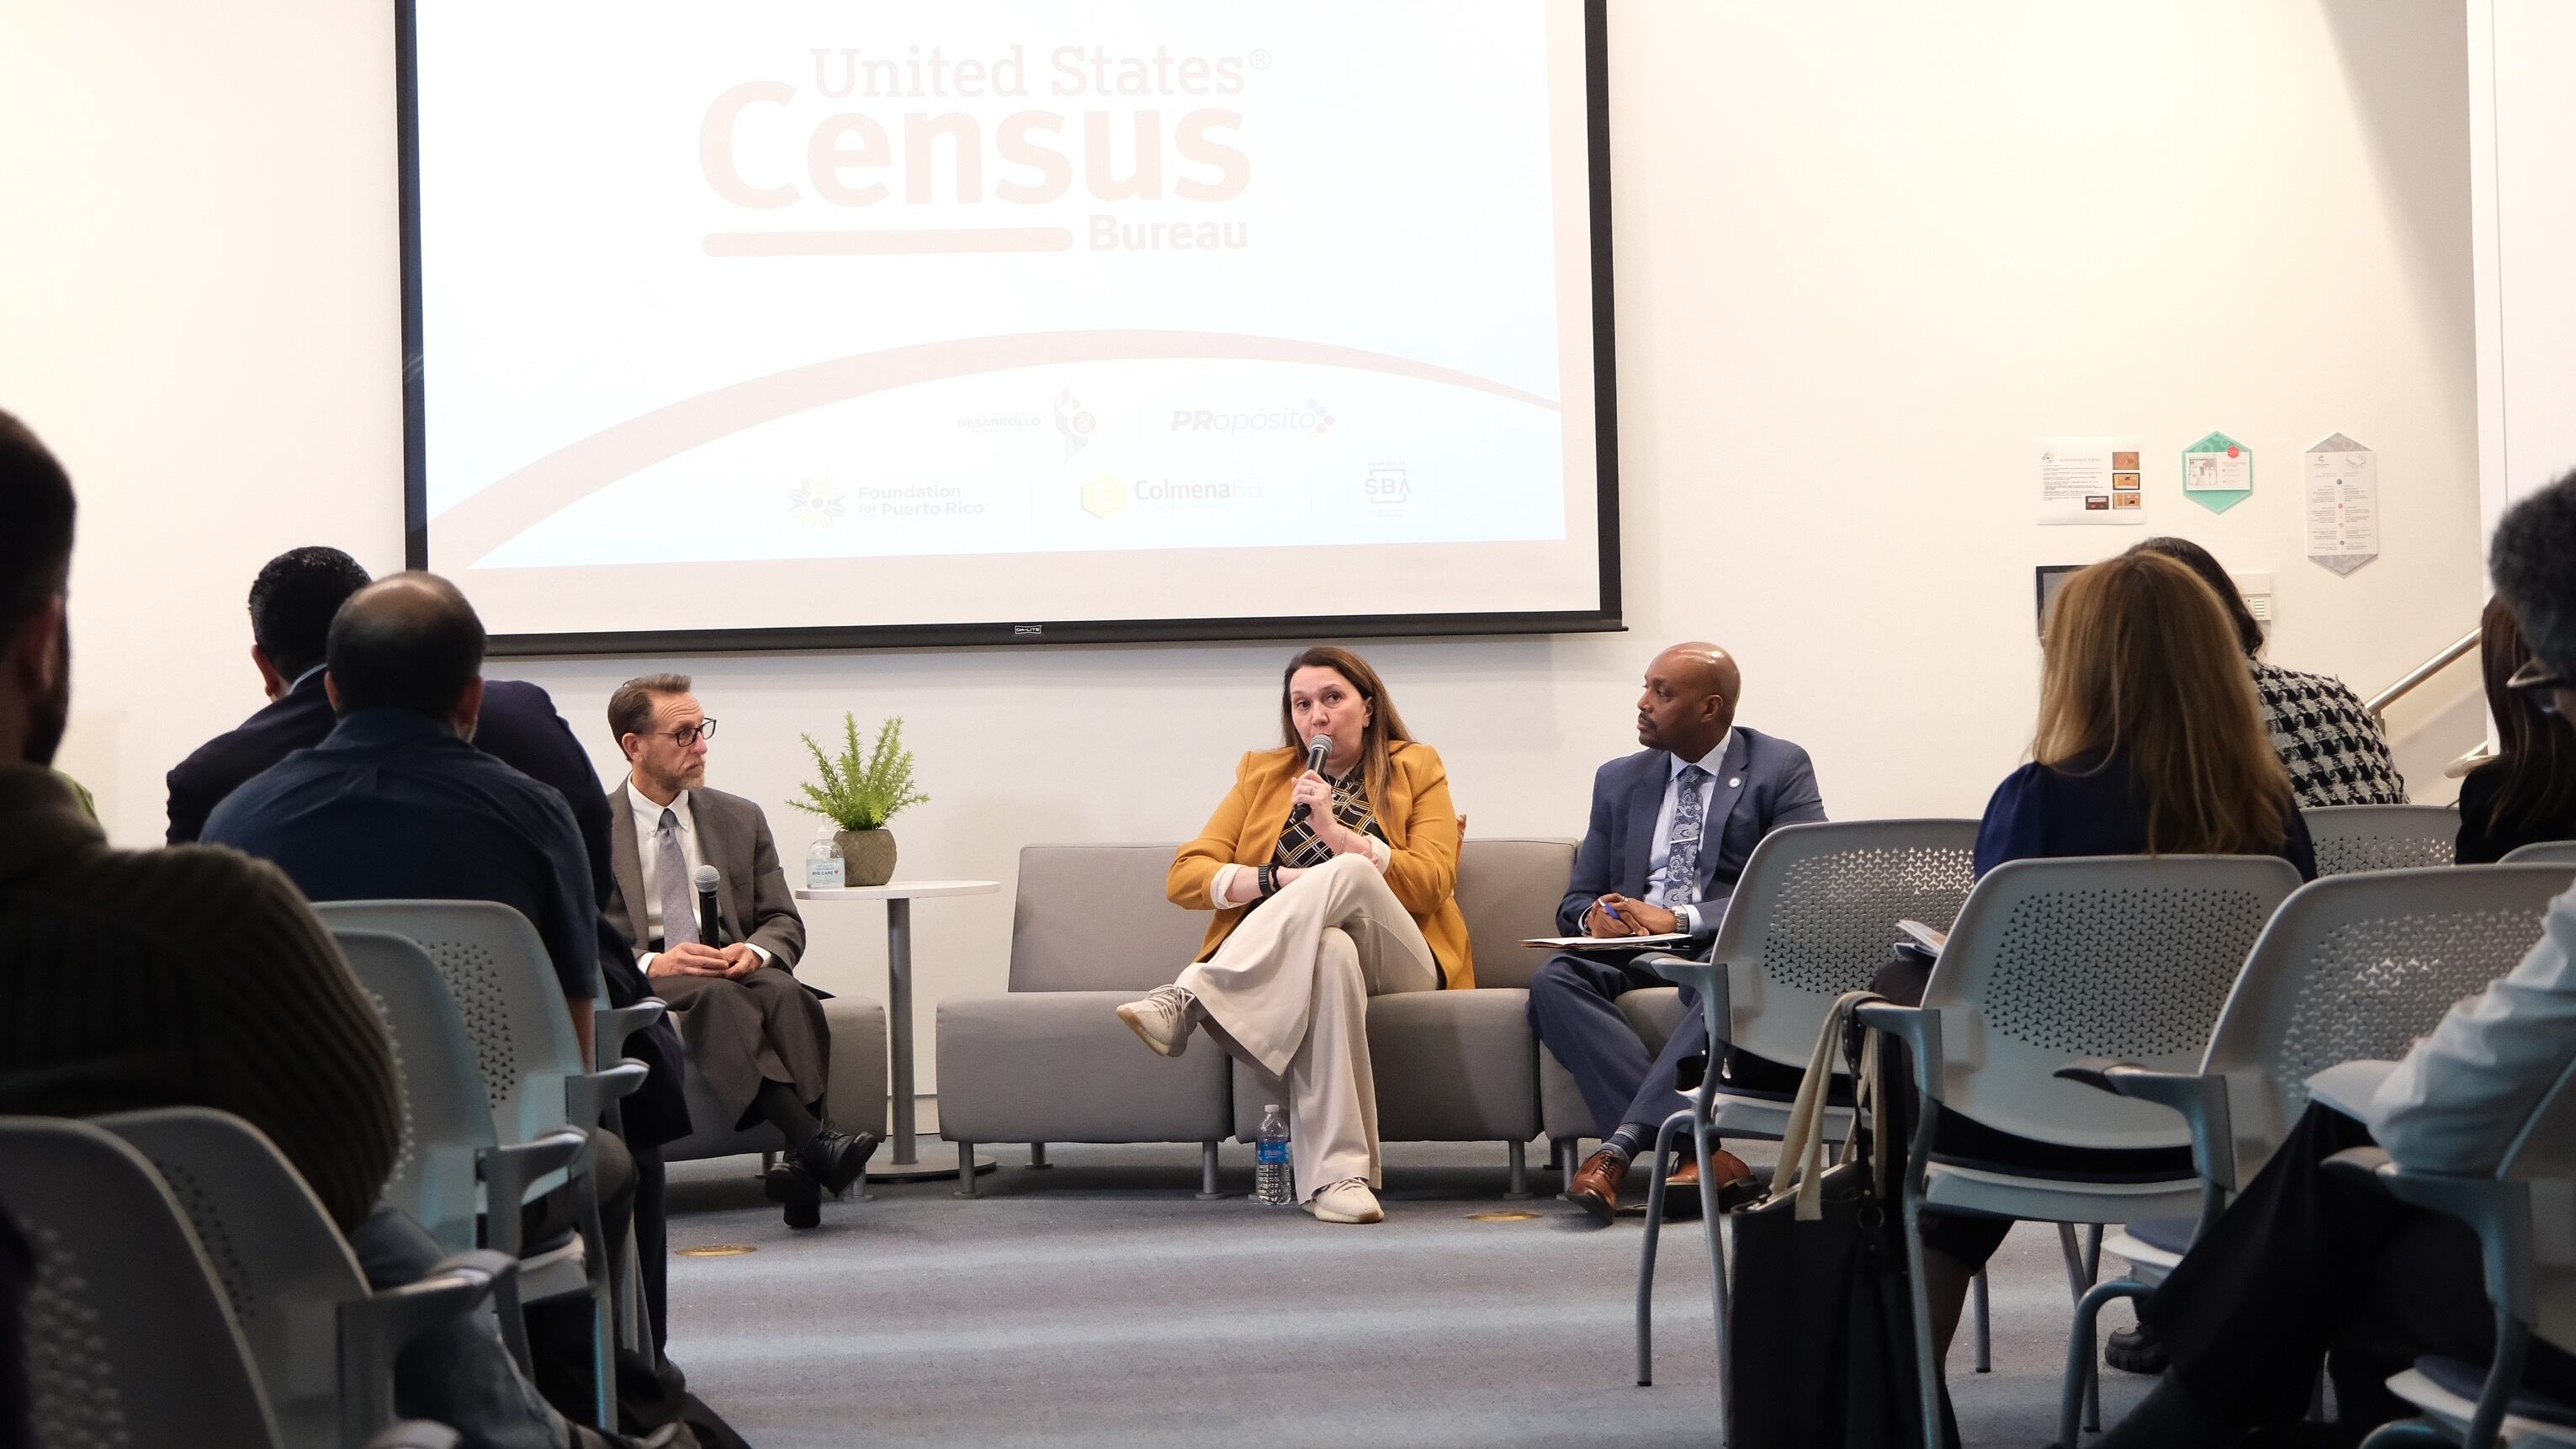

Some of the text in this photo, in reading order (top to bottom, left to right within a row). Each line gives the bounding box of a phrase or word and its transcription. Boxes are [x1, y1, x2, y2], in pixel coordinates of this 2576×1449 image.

[810, 44, 1028, 98] United
[699, 80, 1252, 210] Census
[1089, 214, 1249, 252] Bureau
[957, 417, 1042, 429] DESARROLLO
[1171, 406, 1316, 435] PRopósito
[858, 485, 962, 499] Foundation
[1134, 478, 1263, 501] Colmena66
[1365, 477, 1412, 495] SBA
[859, 501, 984, 517] for Puerto Rico
